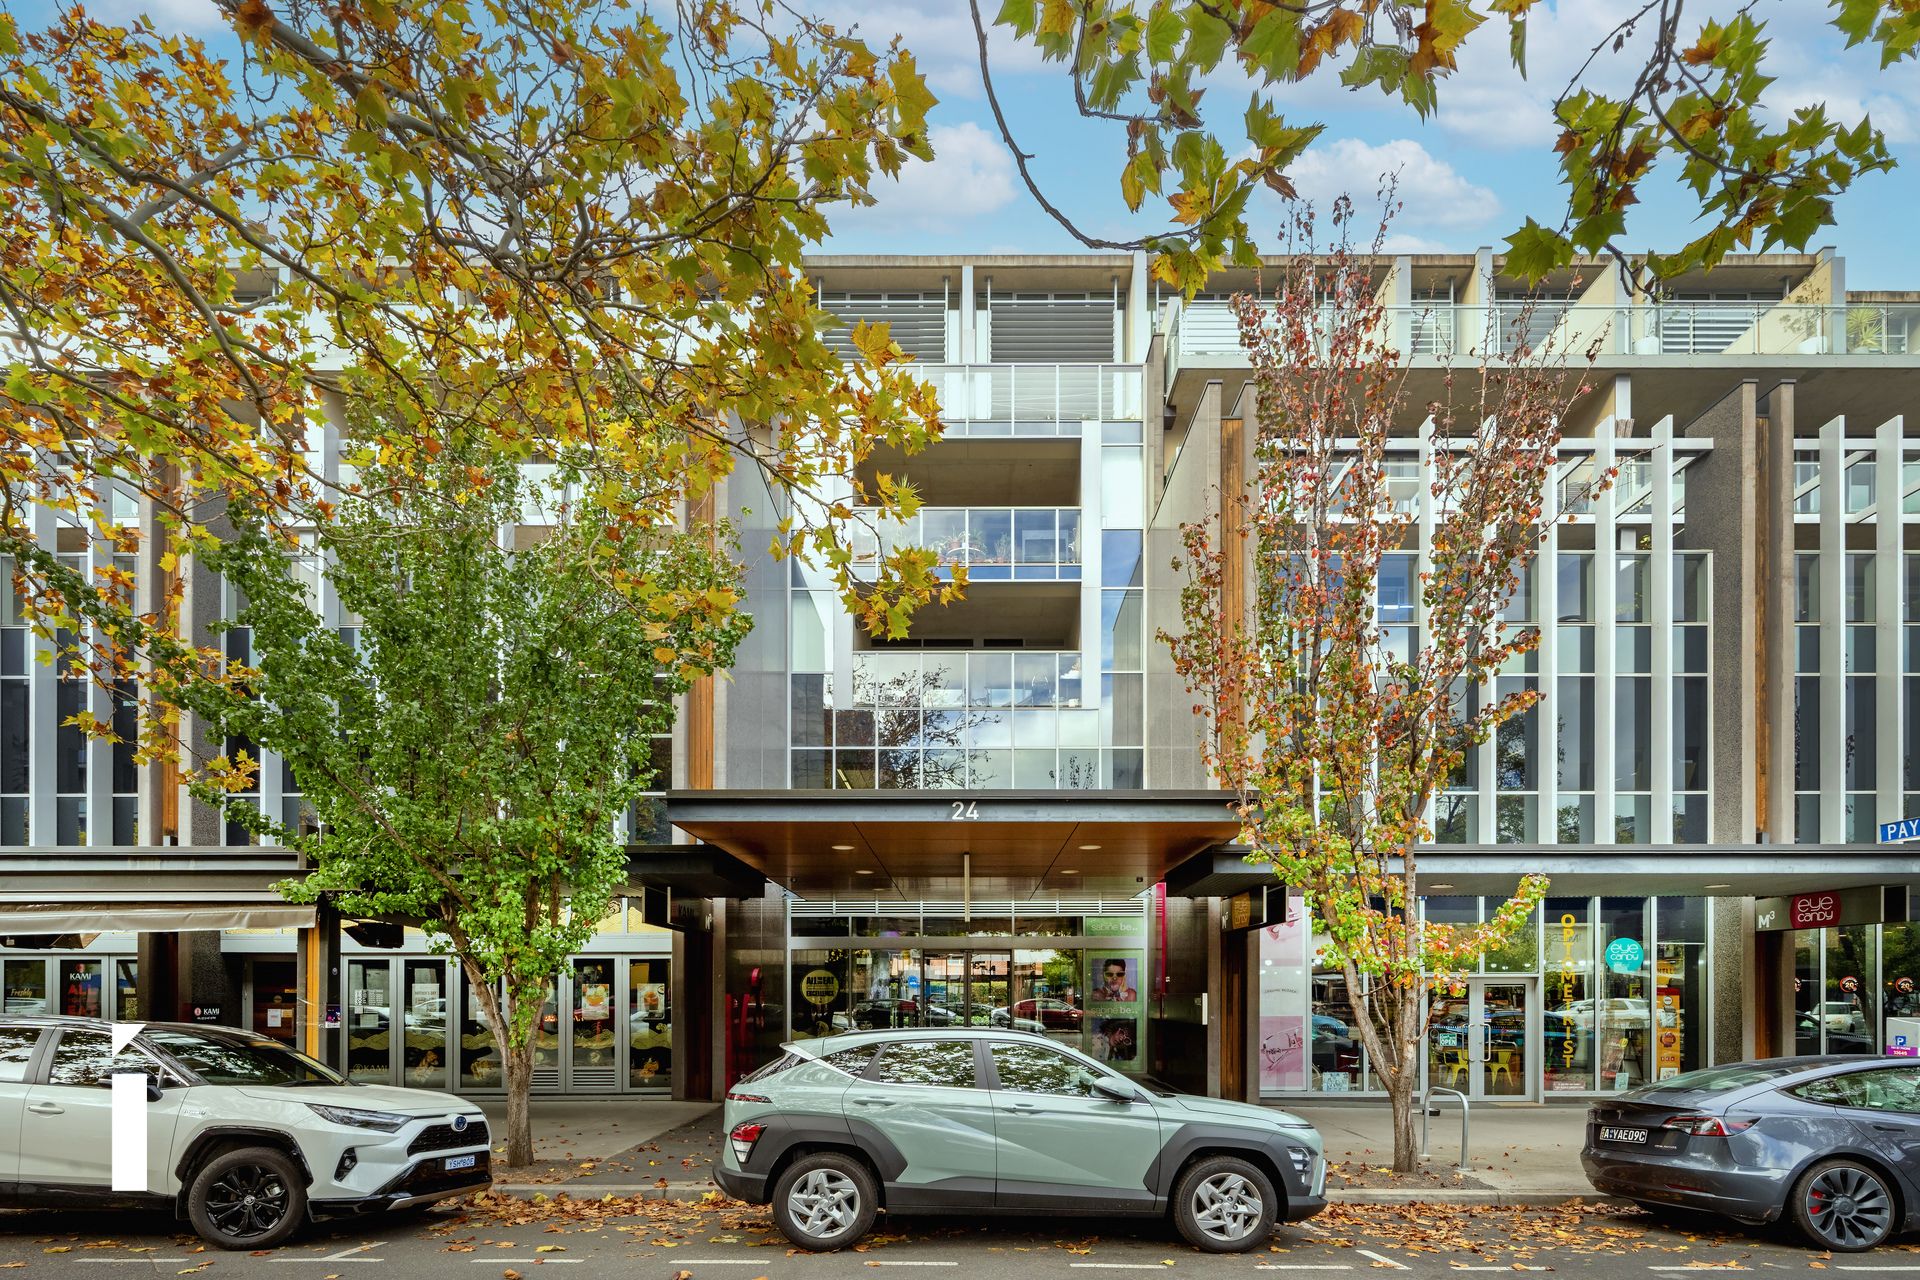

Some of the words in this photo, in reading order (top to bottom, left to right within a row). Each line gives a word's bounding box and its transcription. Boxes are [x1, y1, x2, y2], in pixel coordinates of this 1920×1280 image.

[951, 801, 979, 820] 24
[1887, 819, 1919, 840] PAY
[1797, 896, 1833, 912] eye
[1610, 943, 1639, 955] eye
[70, 972, 91, 981] KAMI
[10, 988, 32, 998] Freshly
[1560, 913, 1576, 1069] OPTOMETRIST
[203, 1007, 220, 1015] KAMI
